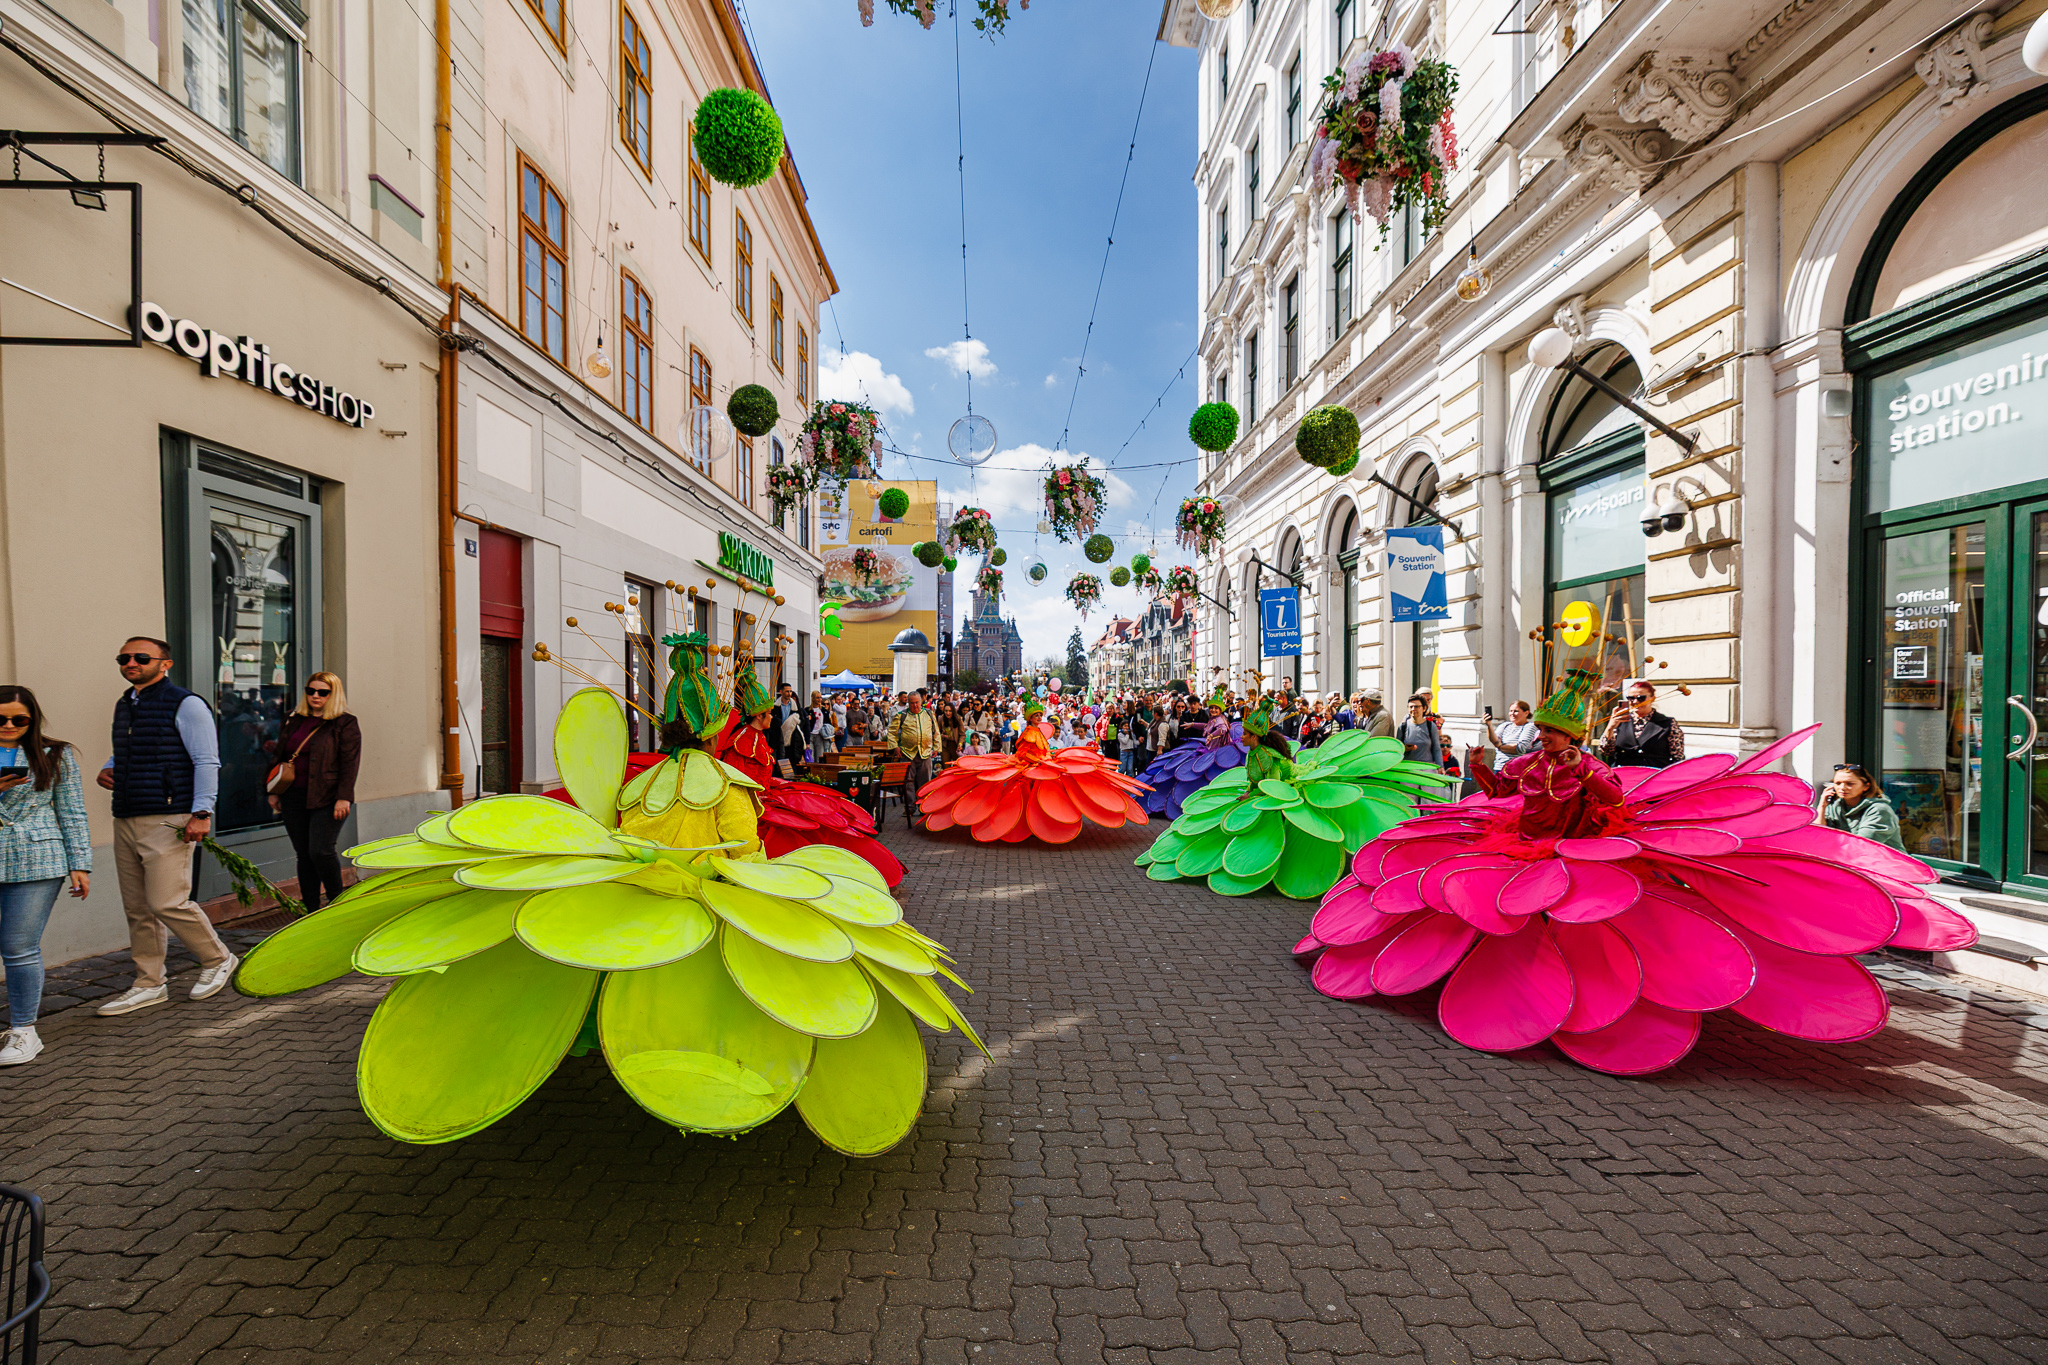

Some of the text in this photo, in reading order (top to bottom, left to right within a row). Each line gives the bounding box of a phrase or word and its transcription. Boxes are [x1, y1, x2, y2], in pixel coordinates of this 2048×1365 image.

[1887, 352, 2048, 421] Souvenir
[1890, 402, 2021, 453] station.
[859, 527, 892, 536] cartofi
[721, 531, 774, 587] SPARTAN
[1398, 554, 1437, 563] Souvenir
[1402, 562, 1435, 571] Station
[1896, 587, 1949, 603] Official
[1895, 601, 1961, 618] Souvenir
[1894, 617, 1948, 632] Station
